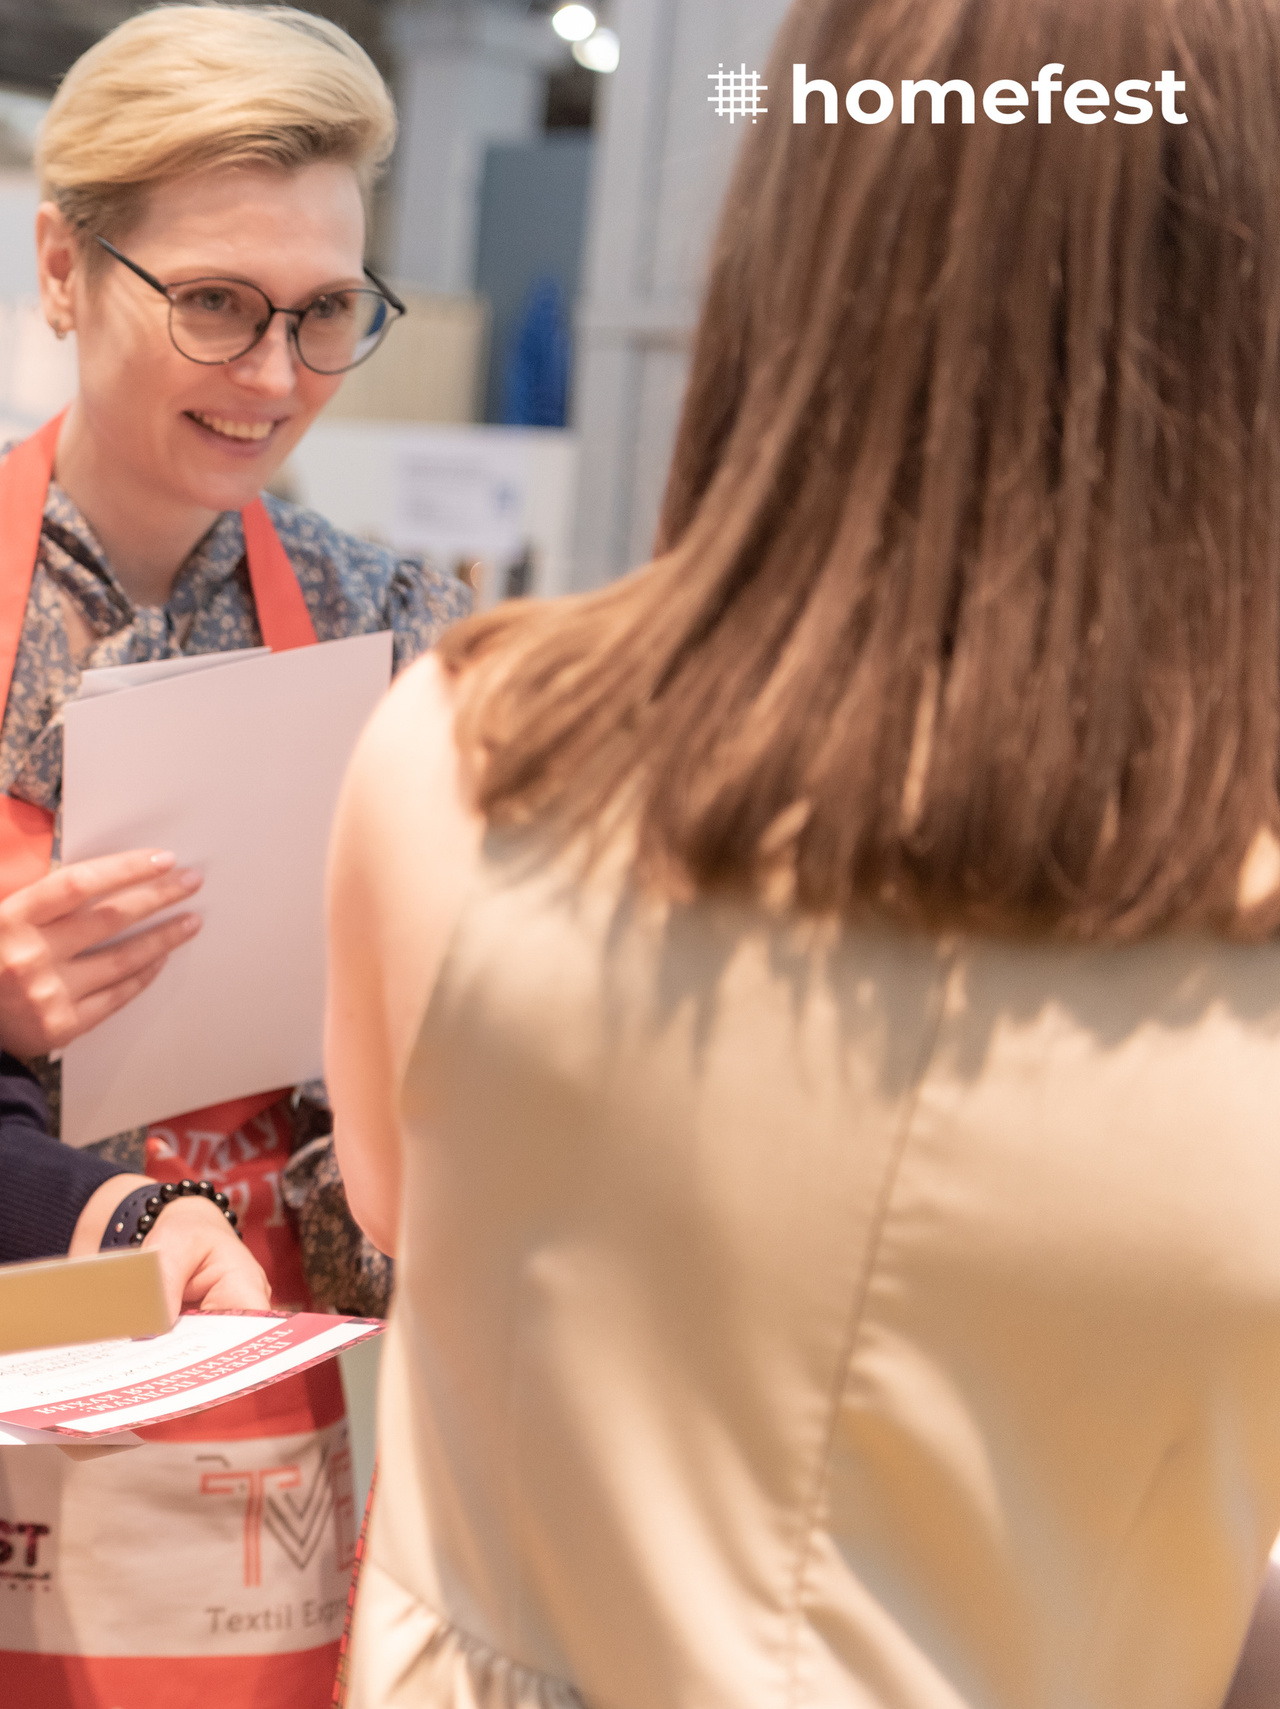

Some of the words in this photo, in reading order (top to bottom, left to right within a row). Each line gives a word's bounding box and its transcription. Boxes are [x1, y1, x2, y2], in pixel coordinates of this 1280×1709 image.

[127, 1328, 294, 1396] ТЕКСТИЛЬНАЯ
[202, 1340, 293, 1380] ПРОЕКТ
[34, 1393, 123, 1415] КУХНЯ
[205, 1603, 293, 1634] Textil
